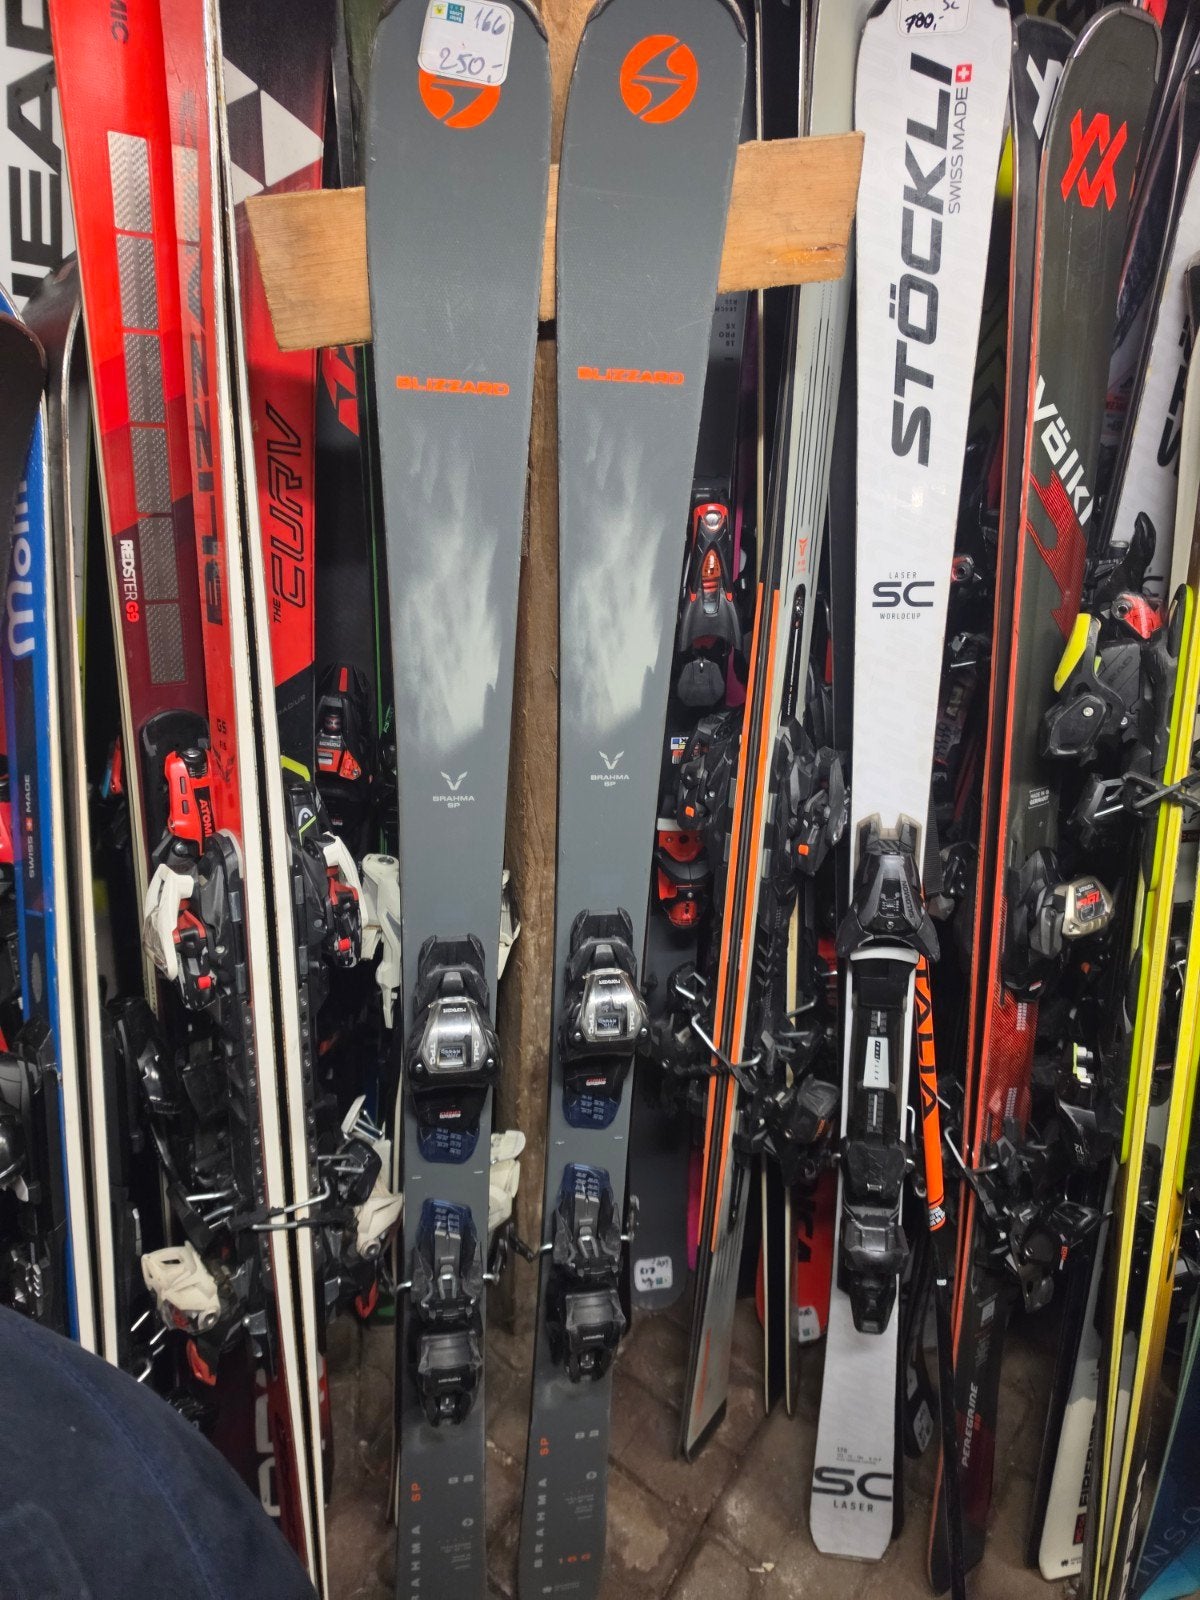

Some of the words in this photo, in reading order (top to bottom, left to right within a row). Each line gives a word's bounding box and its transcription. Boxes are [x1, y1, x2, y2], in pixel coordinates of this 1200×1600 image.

[951, 86, 969, 150] MADE
[948, 154, 964, 214] SWISS
[888, 52, 953, 467] STÖCKLI
[396, 376, 510, 396] BLIZZARD
[577, 366, 685, 385] BLIZZARD
[266, 404, 307, 609] CURV
[119, 539, 138, 601] REDSTER
[888, 572, 917, 580] LASER
[872, 581, 935, 608] SC
[272, 599, 282, 623] THE
[879, 612, 921, 620] WORLDCUP
[961, 1381, 979, 1468] PEREGRINE
[540, 1437, 549, 1456] SP
[411, 1482, 421, 1502] SP
[812, 1465, 893, 1501] SC
[833, 1499, 874, 1513] LASER
[534, 1477, 548, 1568] BRAHMA
